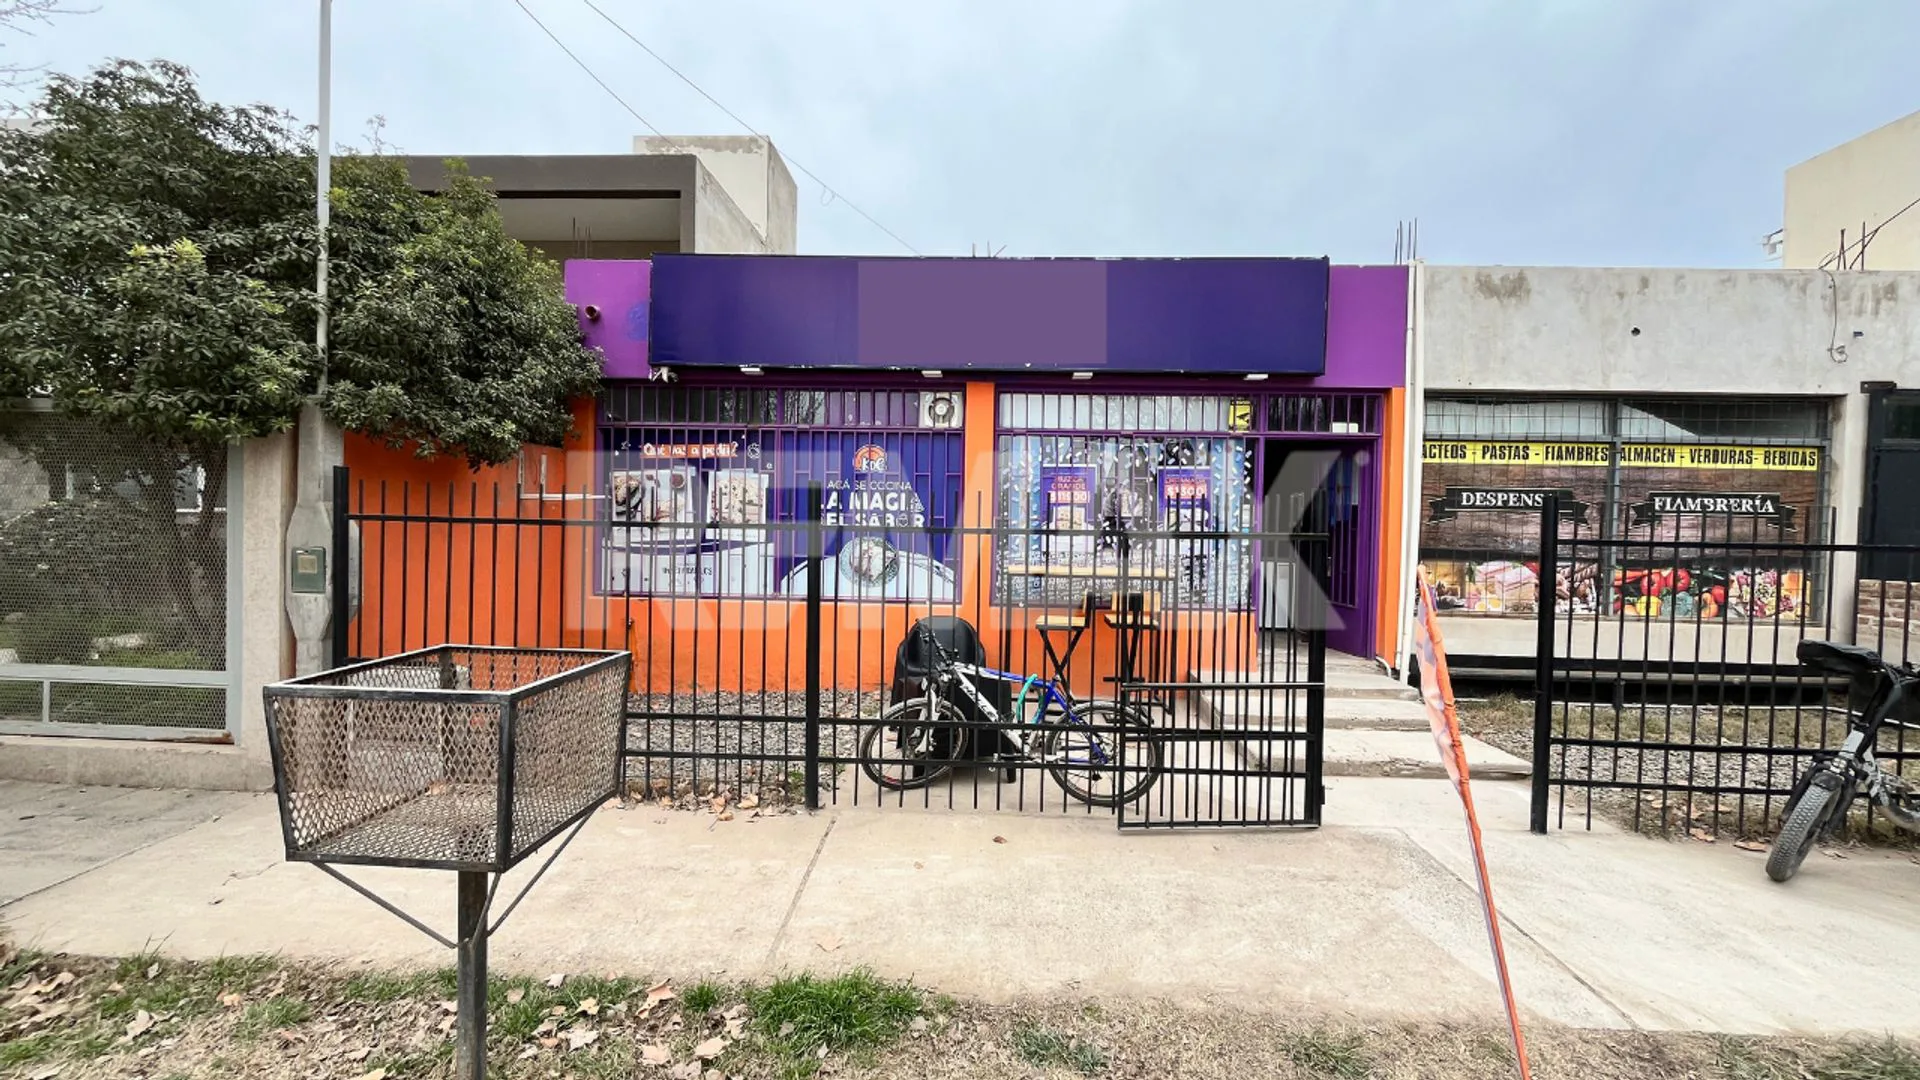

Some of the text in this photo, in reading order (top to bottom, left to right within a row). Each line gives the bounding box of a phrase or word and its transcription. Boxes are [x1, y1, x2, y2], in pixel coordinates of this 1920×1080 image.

[691, 447, 700, 456] a
[1422, 444, 1467, 459] ACTEOS
[1482, 445, 1530, 461] PASTAS
[1545, 446, 1609, 462] FIAMBRES
[1620, 447, 1675, 463] ALMACEN
[1764, 450, 1816, 466] BEBIDAS
[827, 478, 850, 490] ACÁ
[821, 491, 843, 510] A
[1461, 491, 1552, 507] DESPENS
[1653, 495, 1775, 512] FIAMBRERÍA
[821, 513, 848, 528] EL
